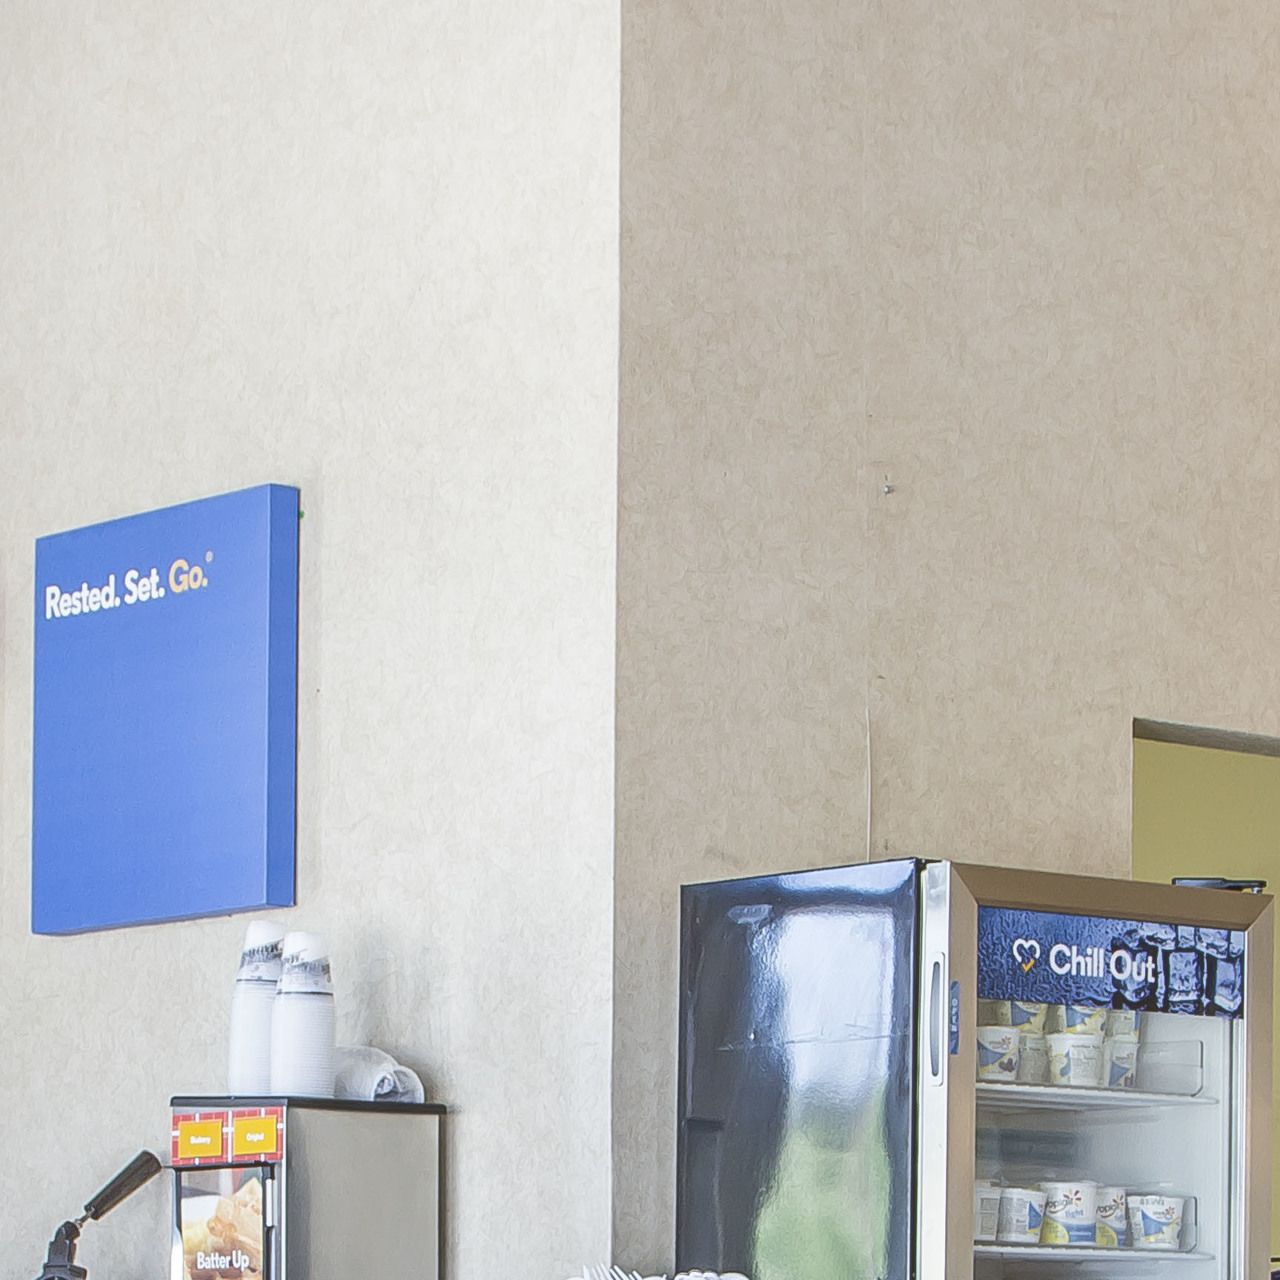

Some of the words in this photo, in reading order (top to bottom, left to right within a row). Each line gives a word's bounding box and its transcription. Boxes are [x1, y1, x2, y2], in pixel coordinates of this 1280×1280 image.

[45, 574, 121, 620] Rested.
[124, 567, 166, 605] Set.
[1048, 943, 1105, 978] Chill
[1109, 949, 1157, 983] Out
[196, 1251, 231, 1270] Batter
[231, 1250, 250, 1271] Up
